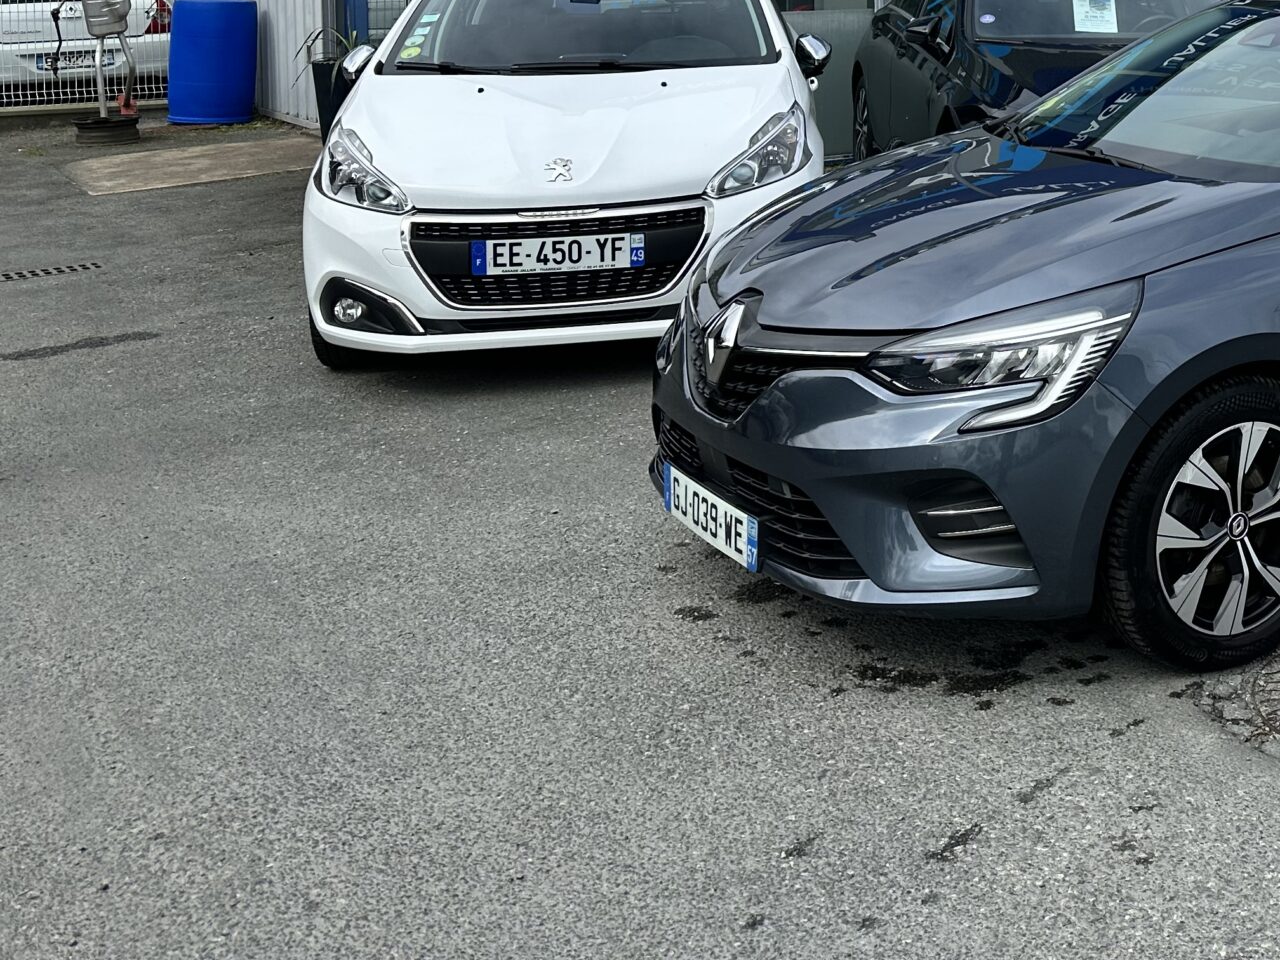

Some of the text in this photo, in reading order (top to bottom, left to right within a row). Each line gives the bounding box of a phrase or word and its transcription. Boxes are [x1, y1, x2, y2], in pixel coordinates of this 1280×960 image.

[492, 236, 626, 268] EE-450-YF
[631, 248, 645, 262] 49
[673, 476, 744, 556] GJ-039-WE
[747, 545, 757, 565] 57
